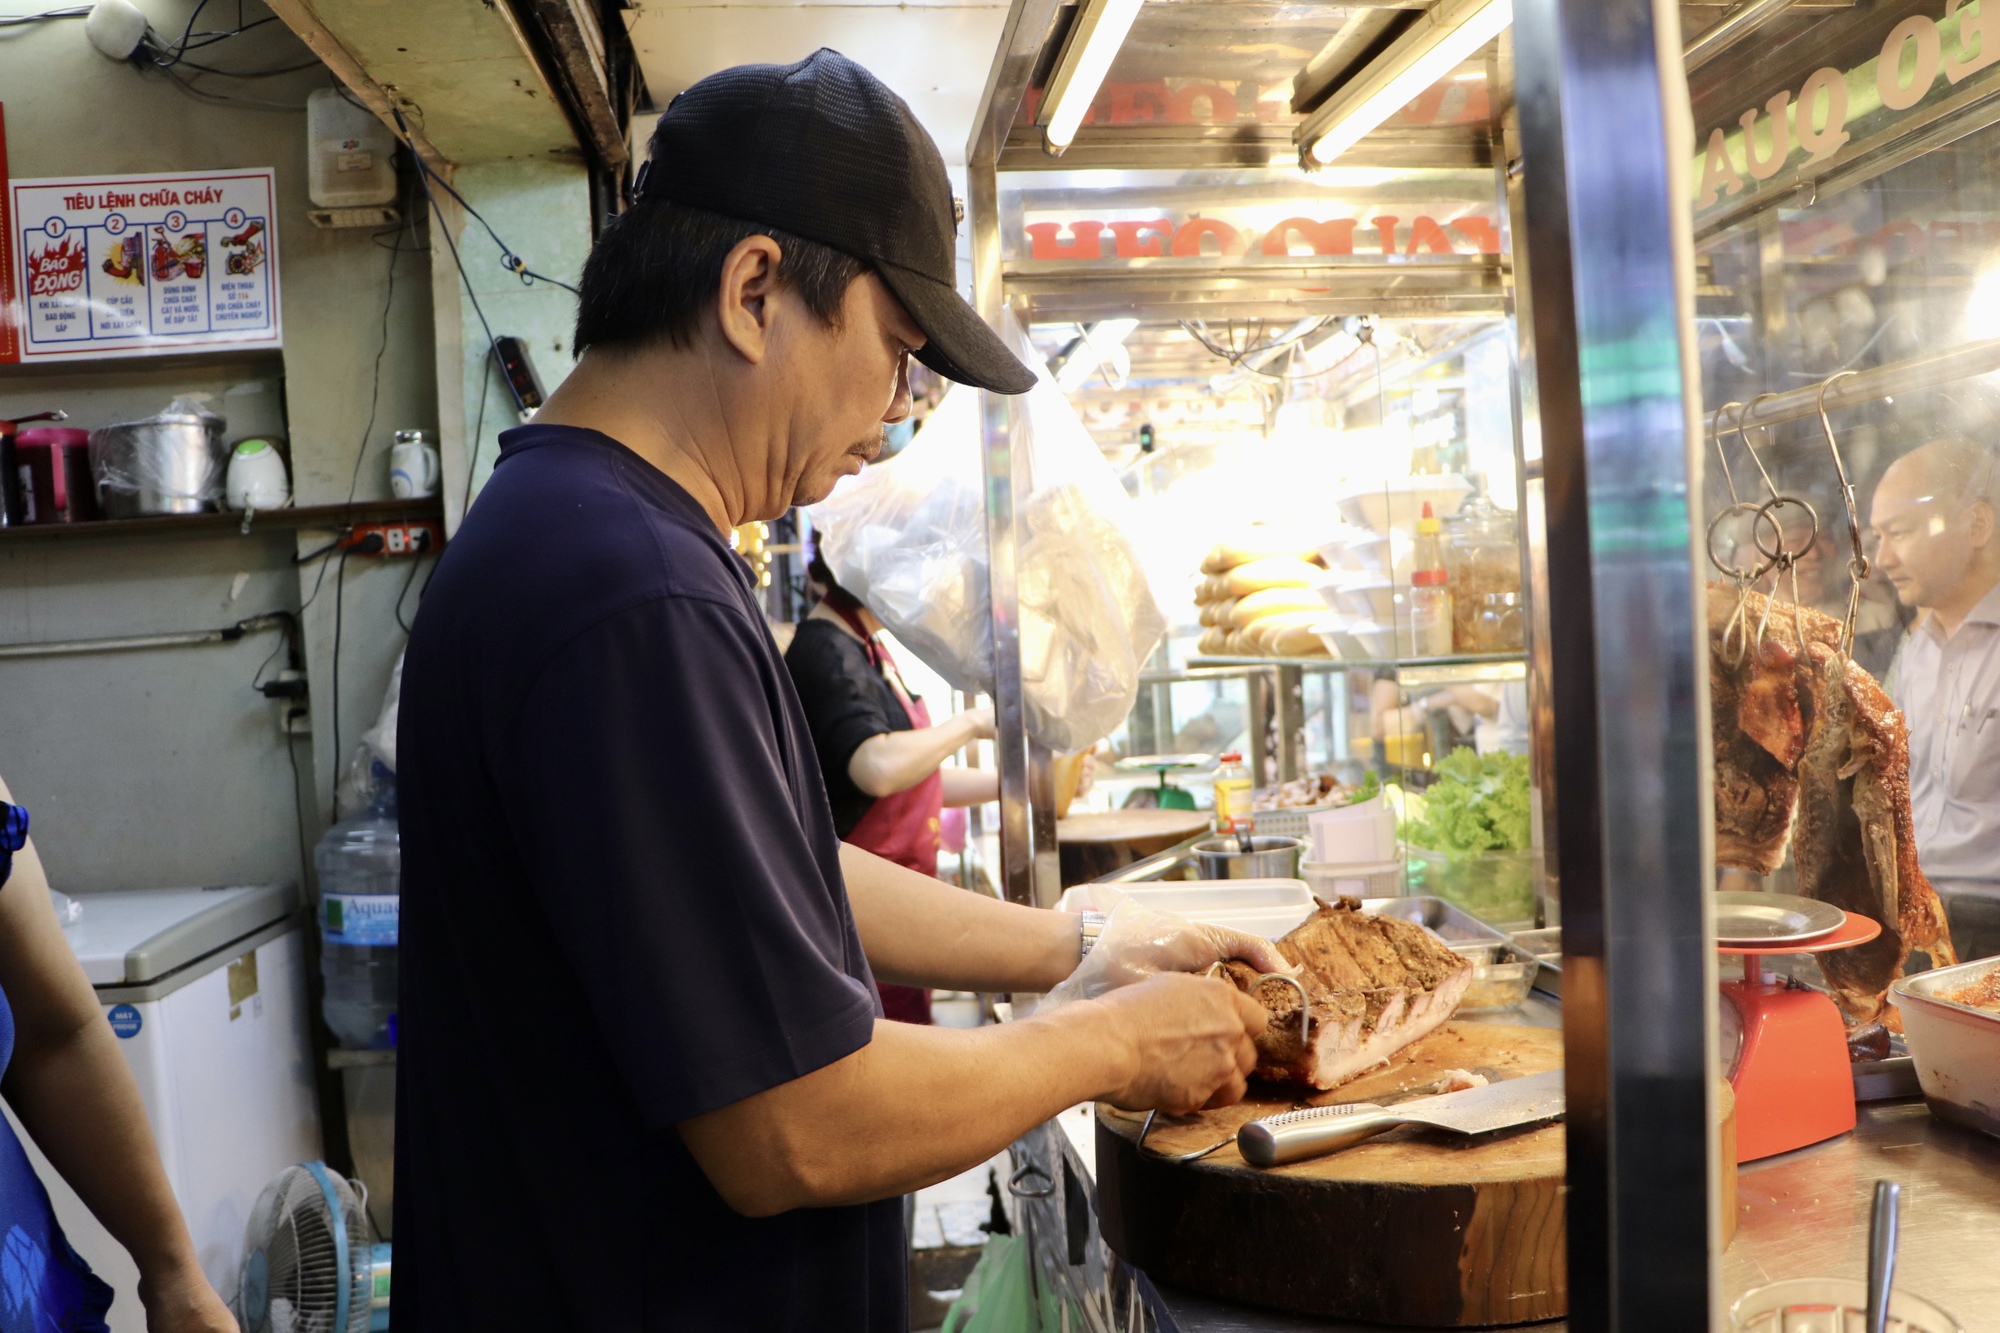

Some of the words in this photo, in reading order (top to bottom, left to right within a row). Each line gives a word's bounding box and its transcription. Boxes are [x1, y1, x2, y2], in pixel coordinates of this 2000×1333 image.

[63, 192, 95, 210] TIÊU
[99, 190, 136, 212] LỆNH
[139, 188, 181, 207] CHỮA
[184, 186, 224, 205] CHÁY
[111, 218, 120, 230] 2
[171, 215, 181, 228] 3
[230, 212, 239, 224] 4
[50, 221, 58, 235] 1
[40, 254, 69, 273] BÁO
[33, 271, 82, 296] ĐỘNG
[238, 292, 249, 300] 114
